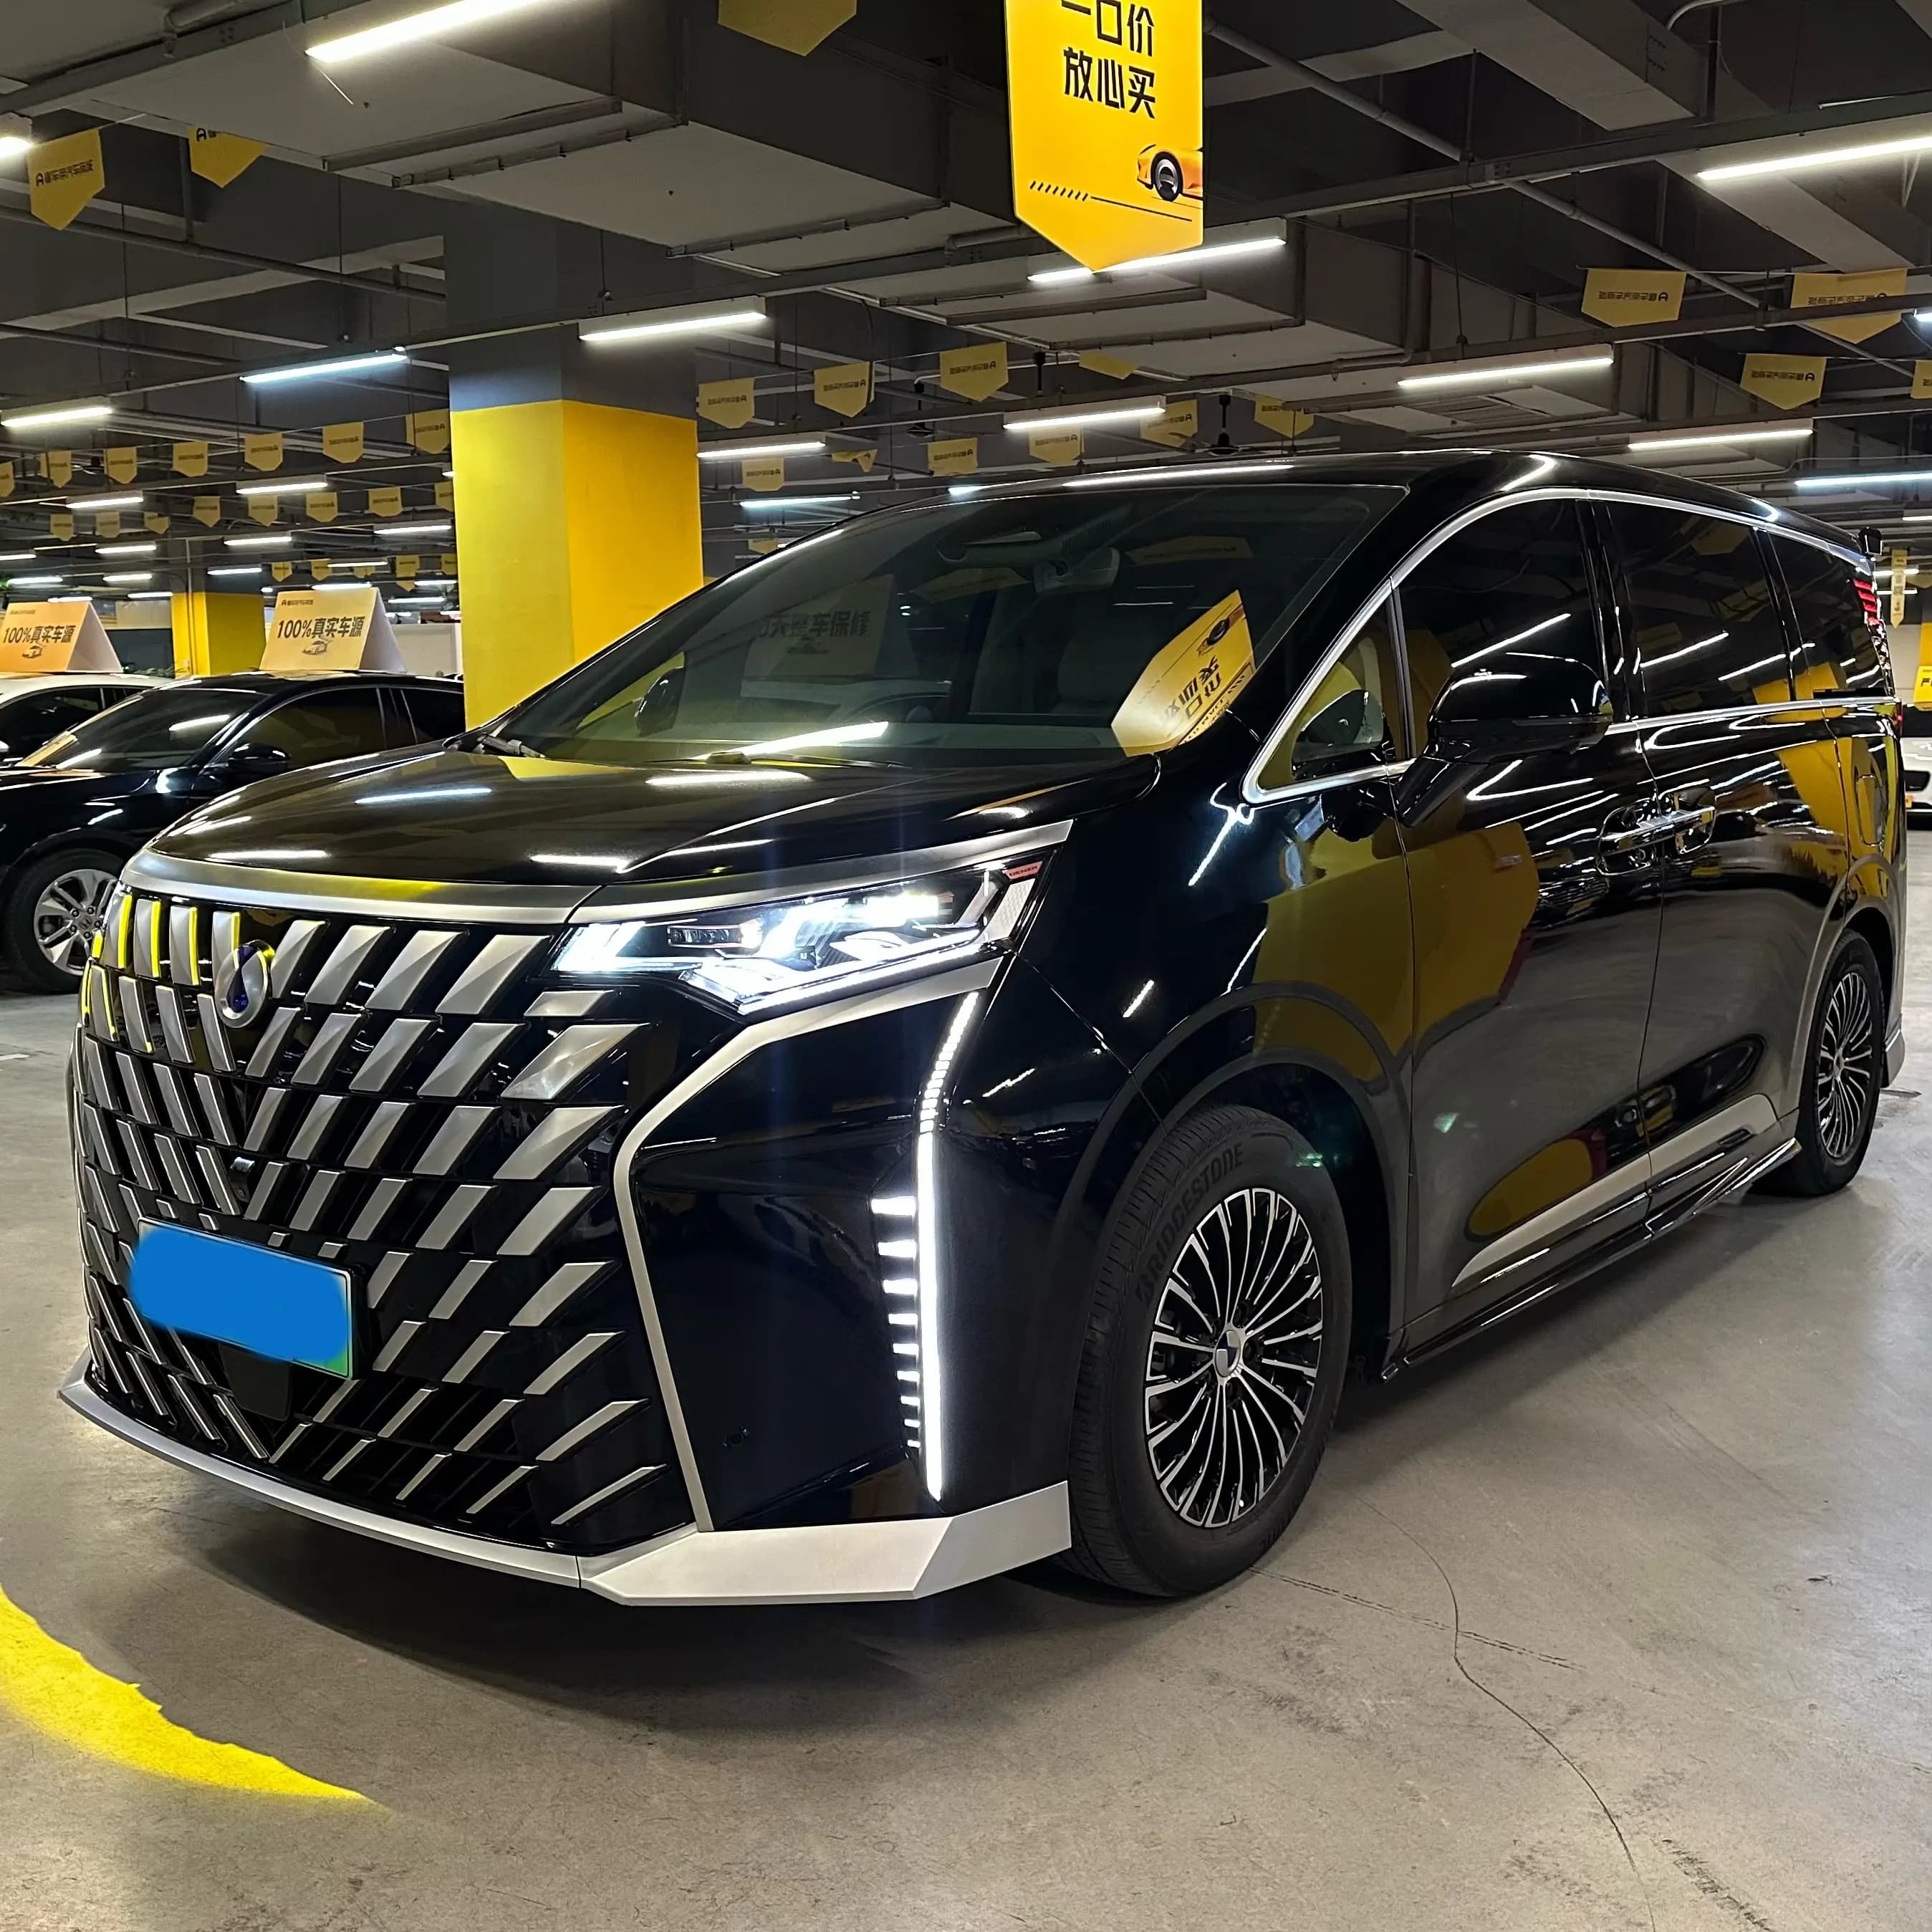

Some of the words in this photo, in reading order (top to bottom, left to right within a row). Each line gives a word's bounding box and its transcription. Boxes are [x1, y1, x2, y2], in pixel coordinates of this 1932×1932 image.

[1061, 0, 1155, 57] 一口价
[1063, 47, 1155, 119] 放心买
[3, 625, 76, 643] 100%真实车源
[277, 616, 365, 638] 100%真实车源
[1134, 1142, 1244, 1302] BRIDGESTONE
